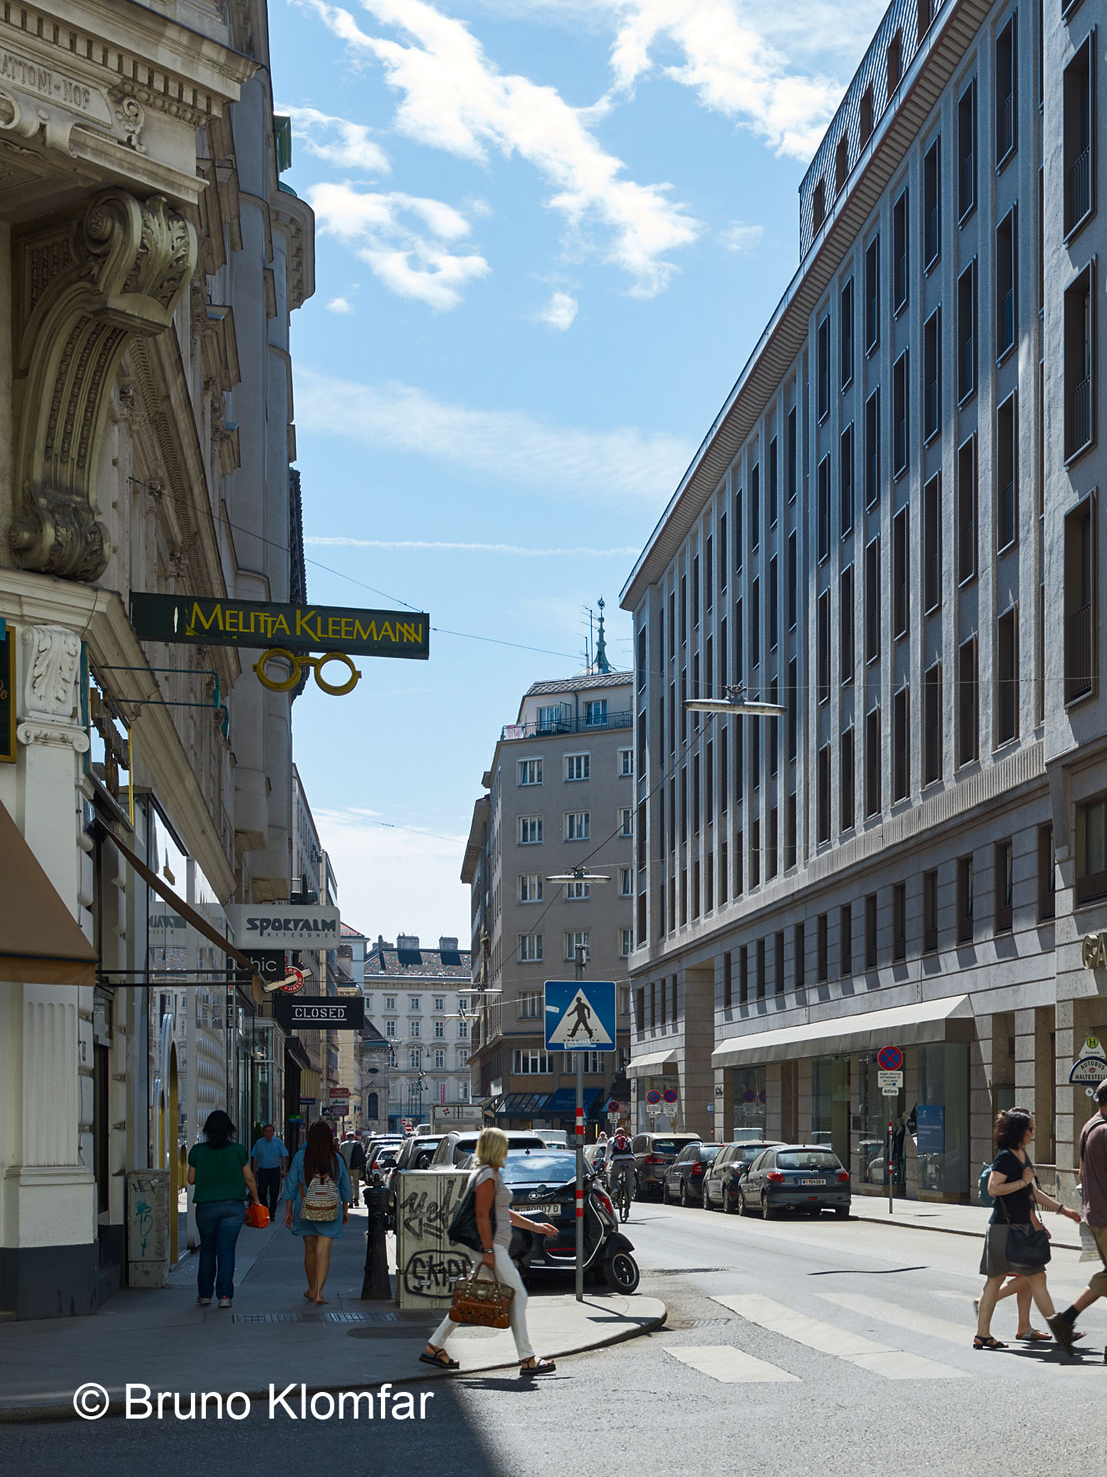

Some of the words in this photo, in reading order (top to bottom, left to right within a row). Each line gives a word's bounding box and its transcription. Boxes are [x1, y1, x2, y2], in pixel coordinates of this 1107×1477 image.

[190, 602, 290, 638] MELITTA
[296, 609, 422, 644] KLEEMANN
[295, 1008, 345, 1019] CLOSED
[1080, 1060, 1105, 1070] AUTOBUS
